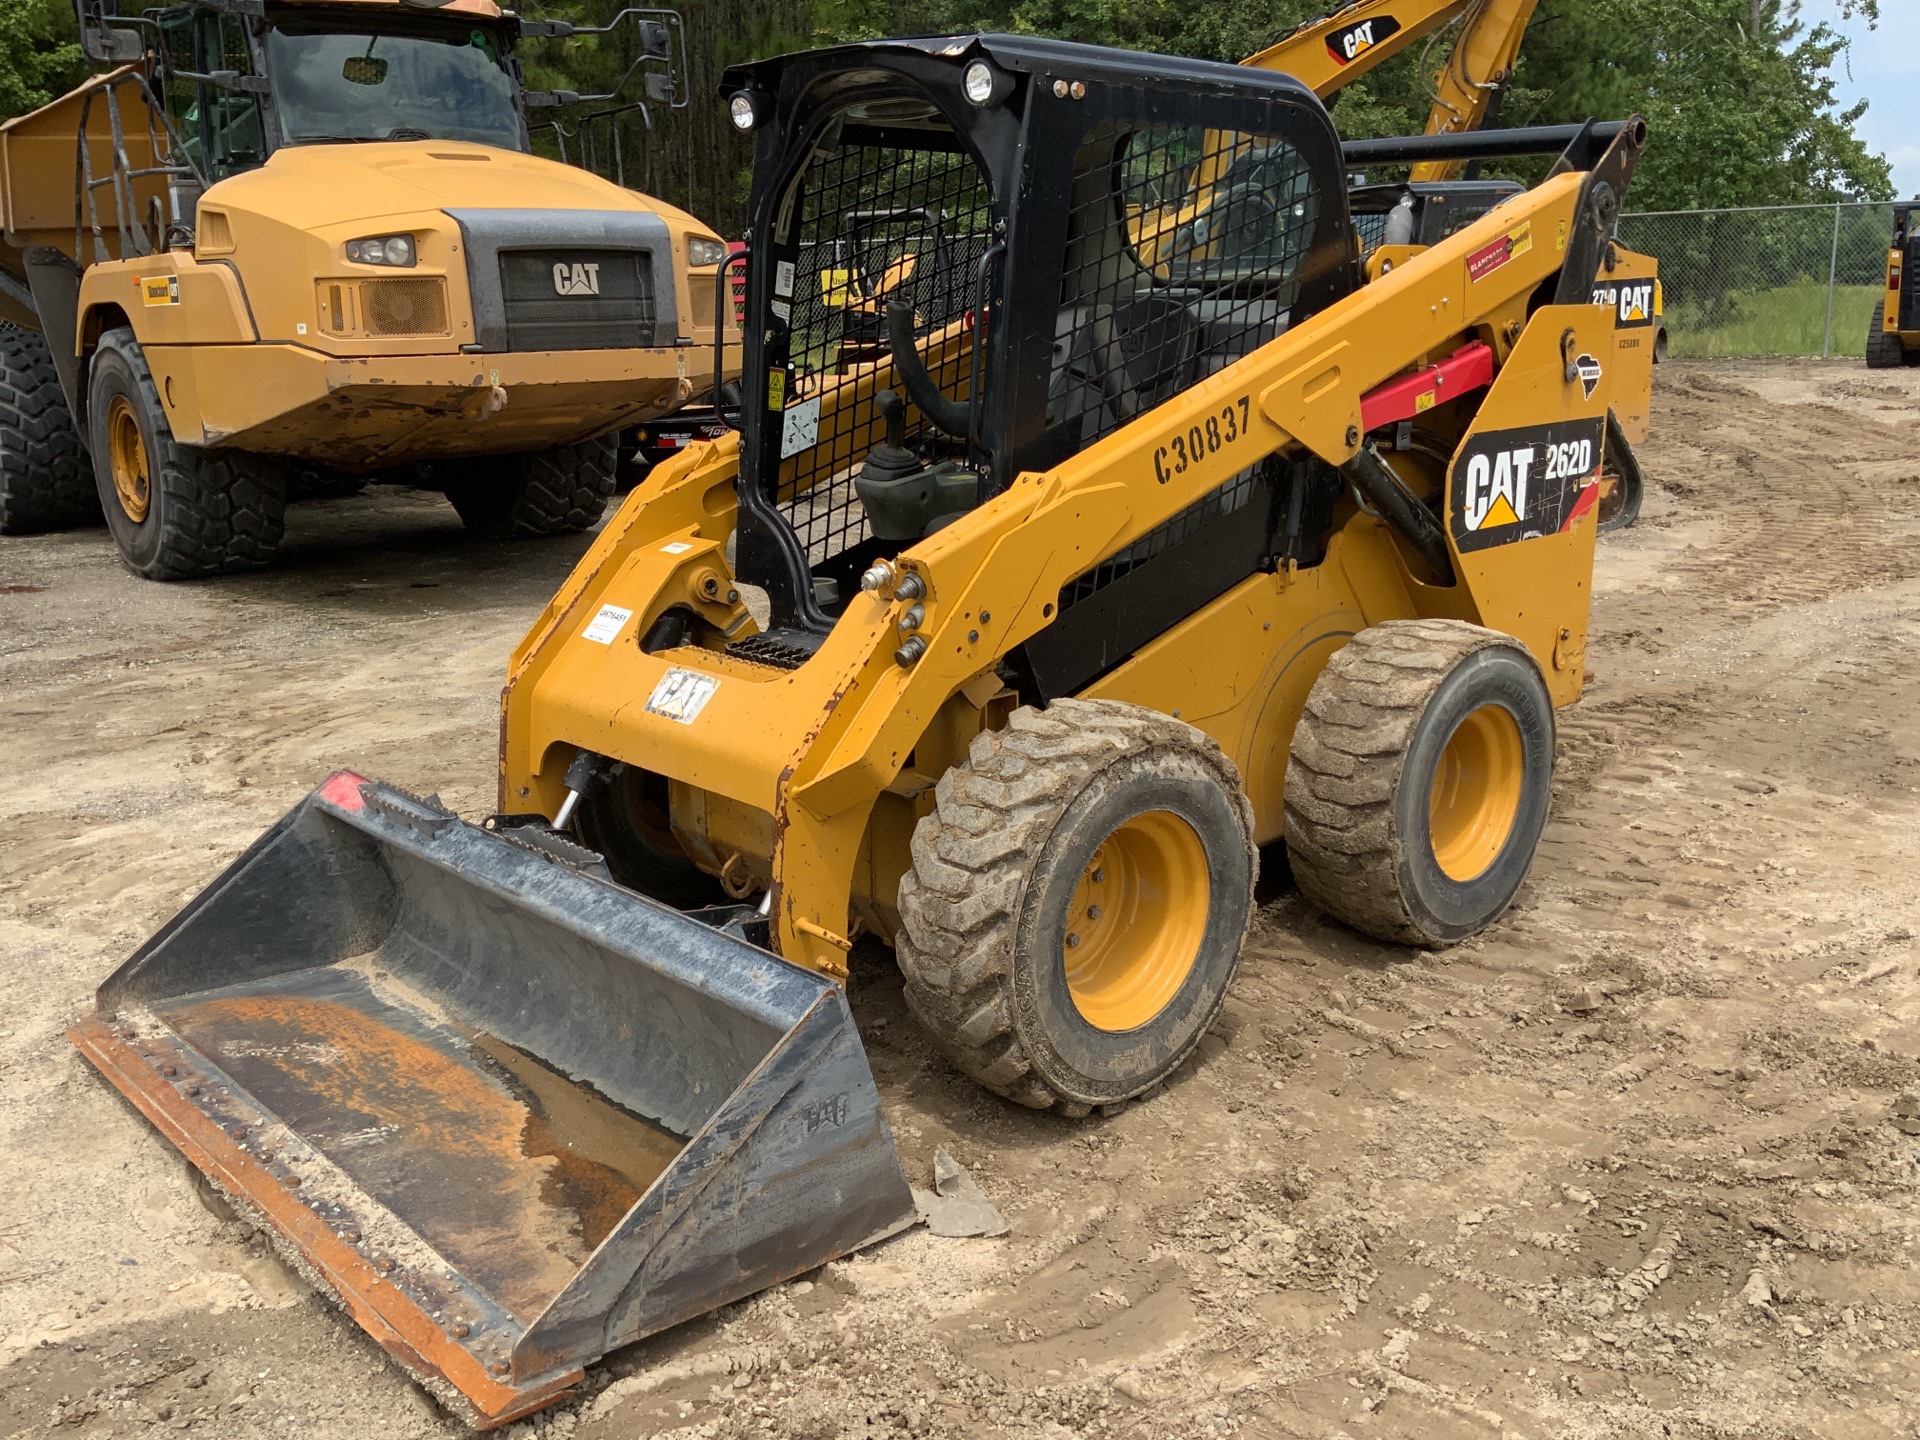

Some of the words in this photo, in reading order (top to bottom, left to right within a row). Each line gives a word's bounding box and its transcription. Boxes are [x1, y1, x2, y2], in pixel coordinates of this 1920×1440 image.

[1343, 21, 1374, 58] CAT
[553, 263, 600, 295] CAT
[1620, 286, 1652, 321] CAT
[1154, 395, 1249, 484] C30837
[1465, 448, 1534, 531] CAT
[1545, 439, 1591, 480] 262D
[650, 674, 715, 720] CAT
